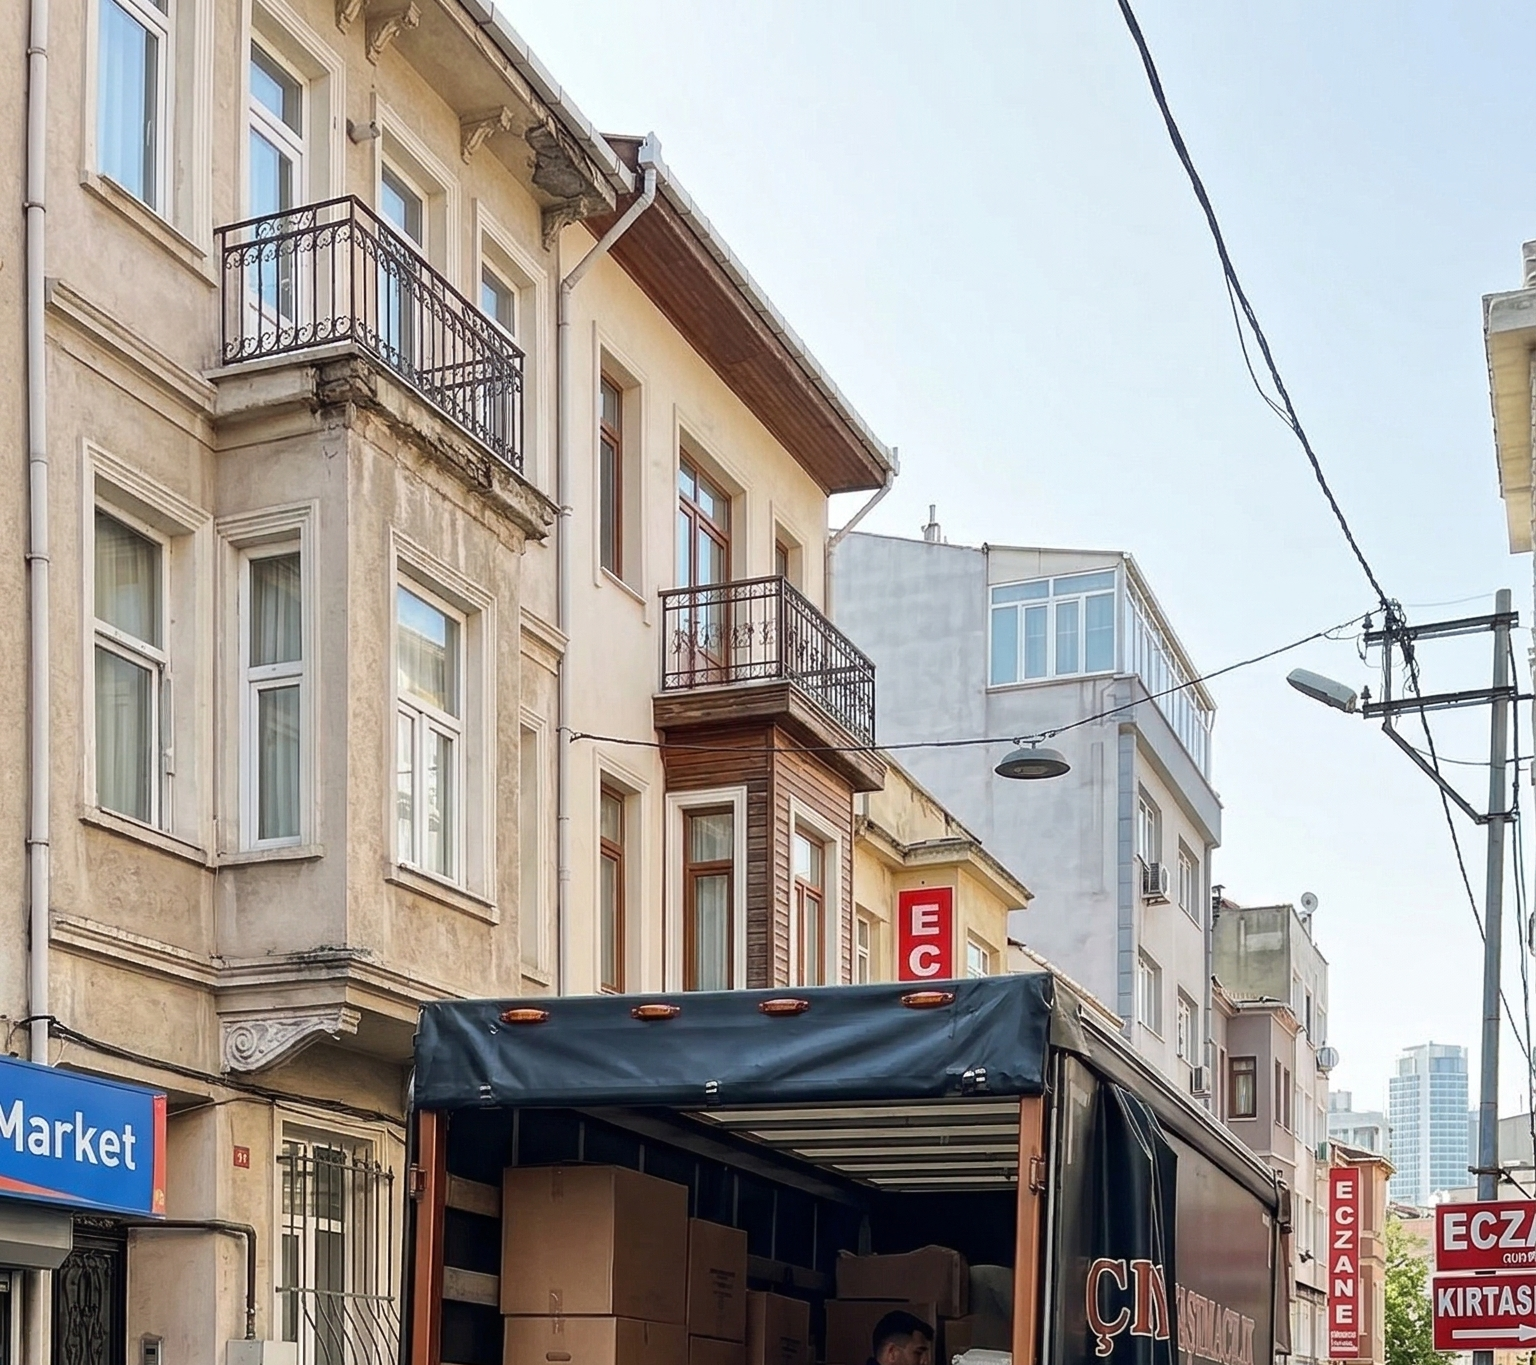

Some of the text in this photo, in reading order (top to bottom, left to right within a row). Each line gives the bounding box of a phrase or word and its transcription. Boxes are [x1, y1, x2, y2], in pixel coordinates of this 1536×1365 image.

[909, 903, 941, 977] EC
[0, 1099, 136, 1171] Market
[1334, 1181, 1354, 1324] ECZANE
[1437, 1285, 1536, 1317] KIRTAS
